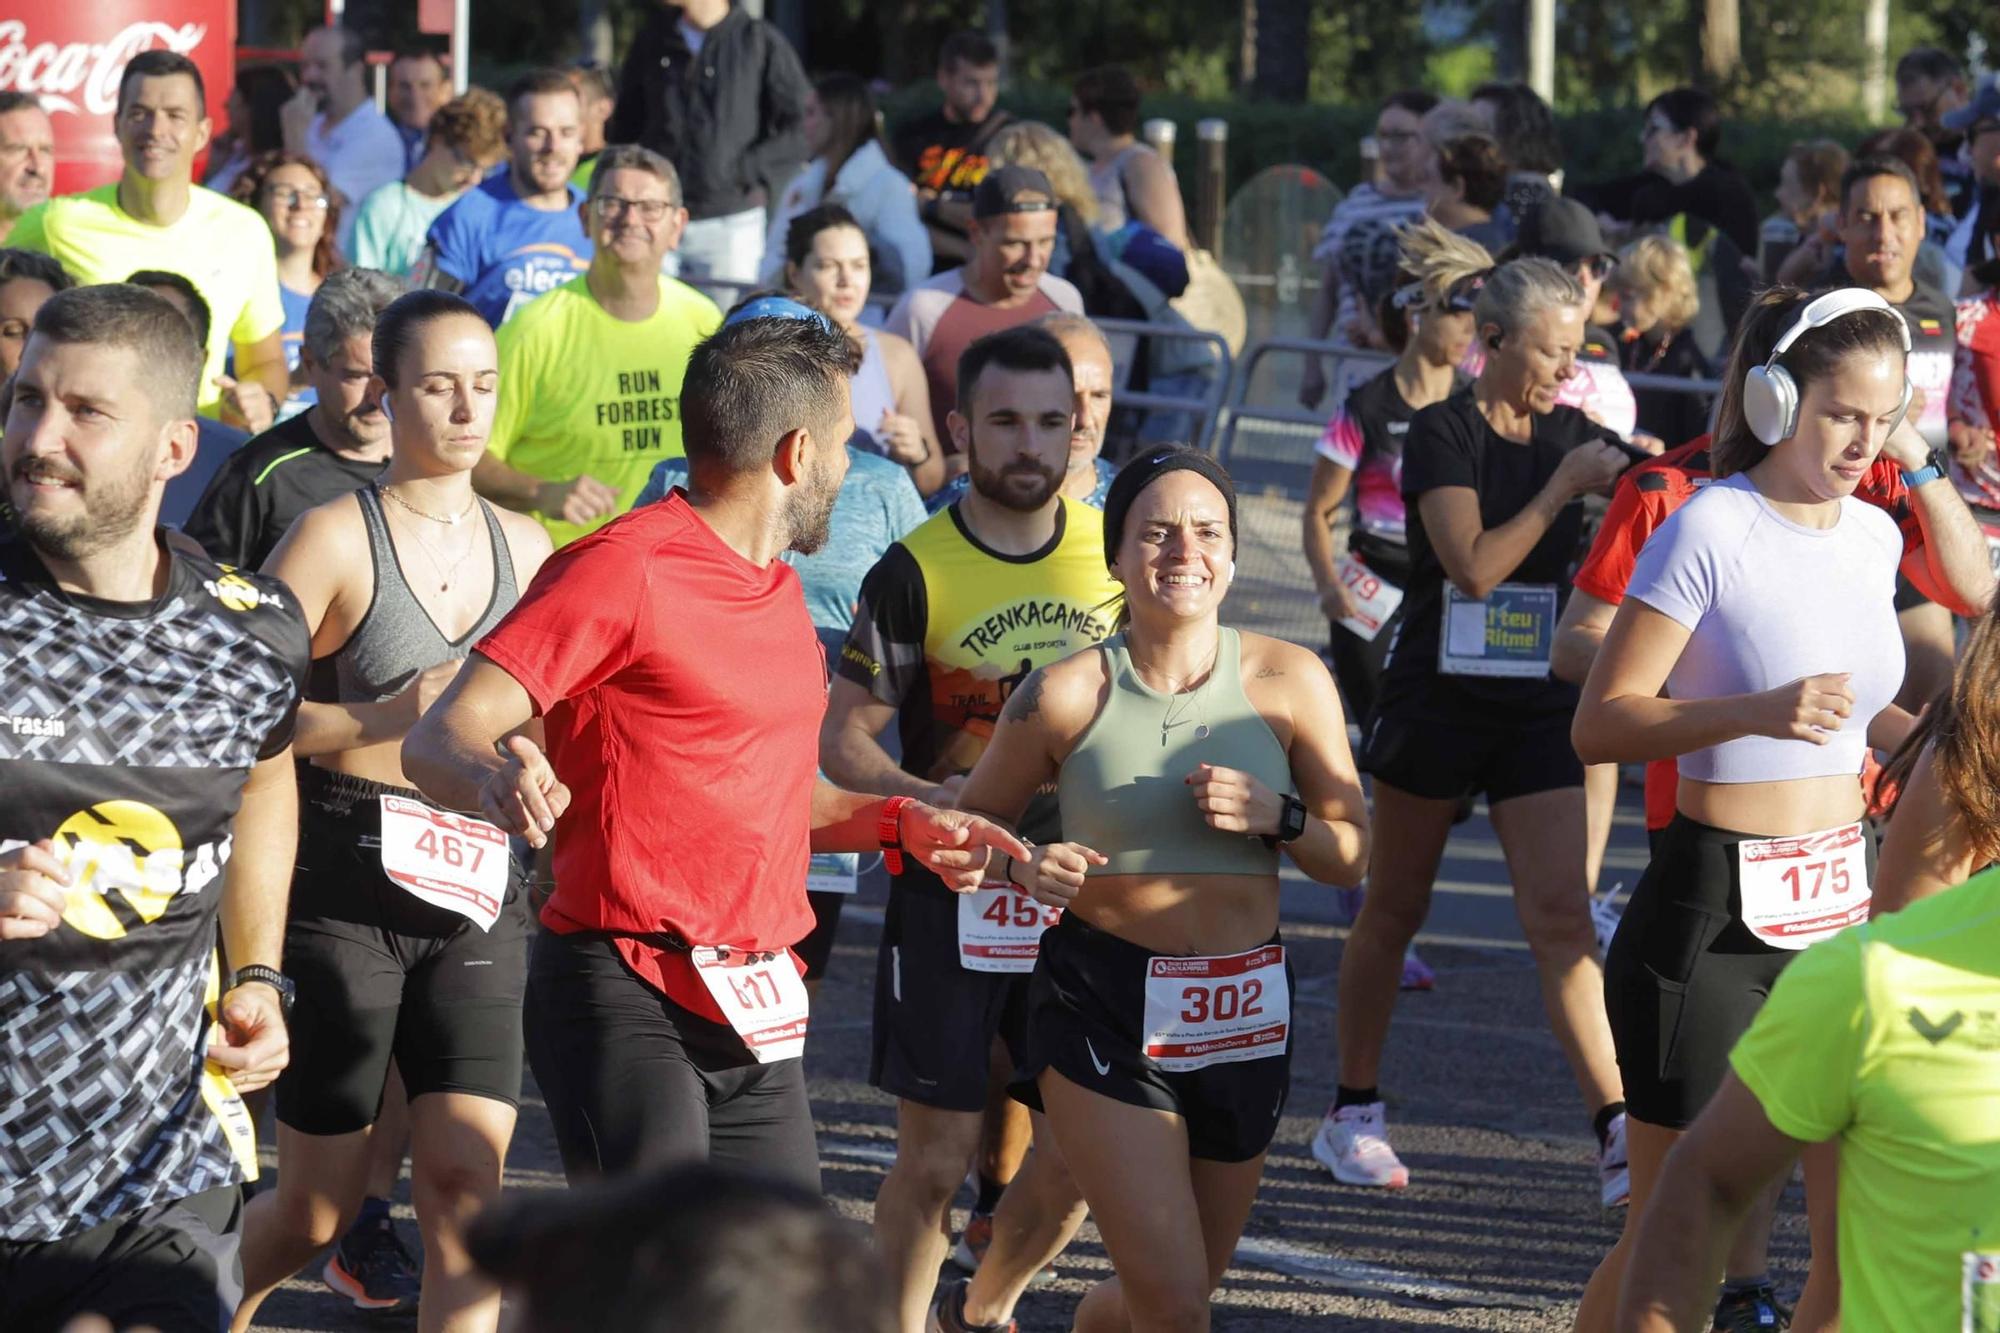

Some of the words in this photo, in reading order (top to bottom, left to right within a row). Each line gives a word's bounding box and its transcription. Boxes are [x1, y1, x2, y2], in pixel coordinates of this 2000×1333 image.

[618, 370, 660, 394] RUN
[623, 428, 661, 452] RUN
[960, 601, 1107, 657] TRENKACAMES
[415, 829, 484, 873] 467
[1781, 857, 1850, 901] 175
[1181, 978, 1263, 1023] 302
